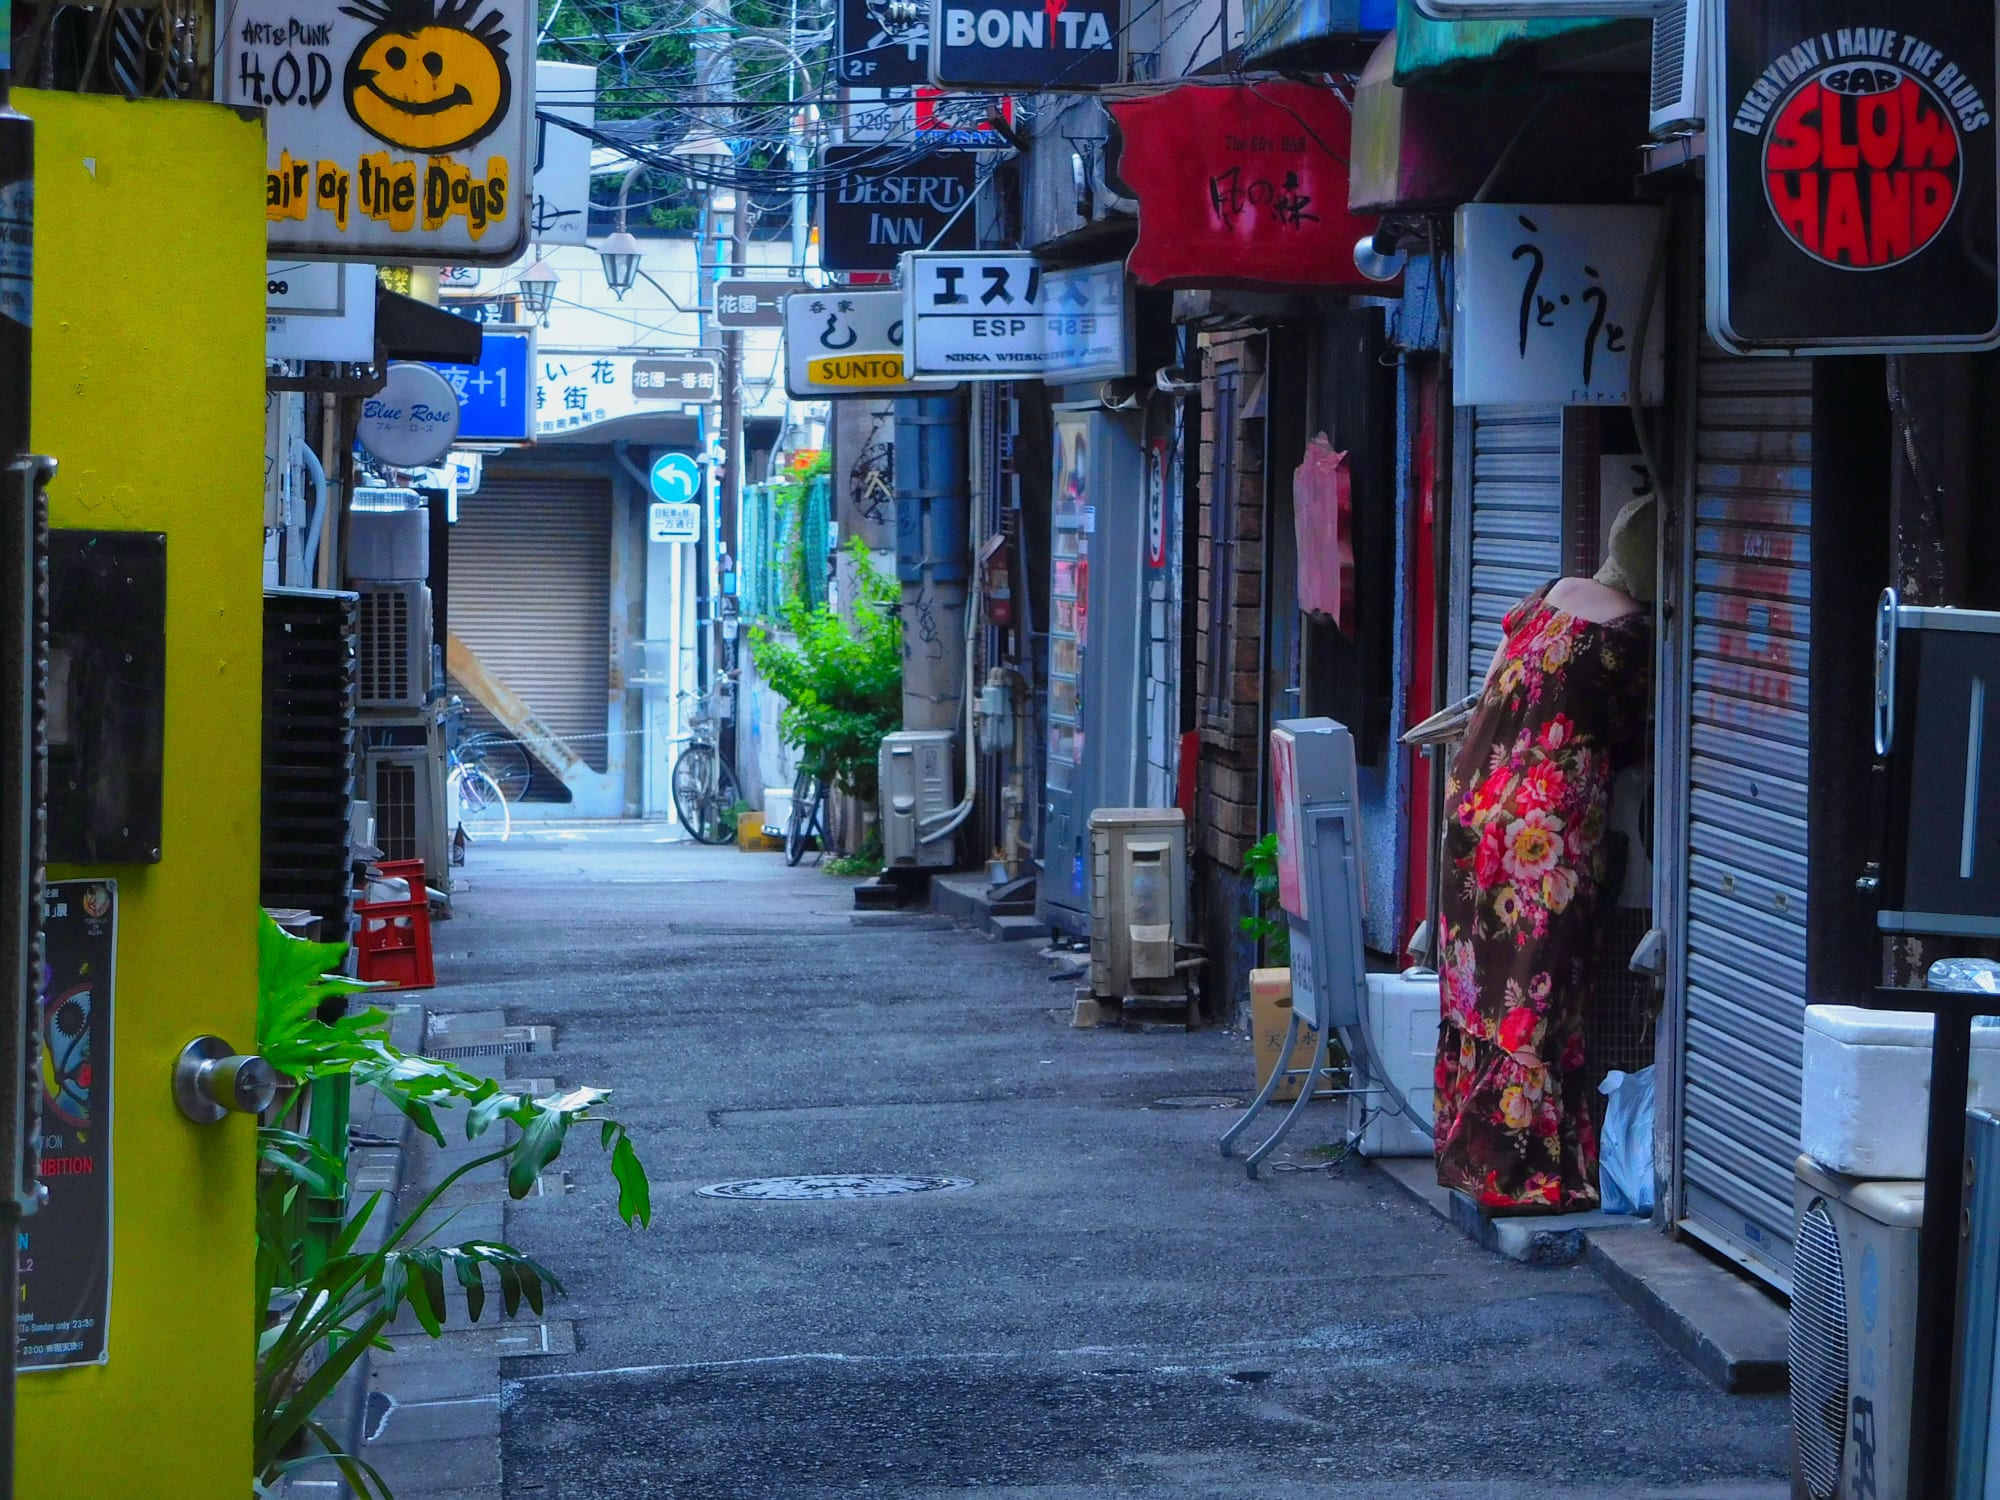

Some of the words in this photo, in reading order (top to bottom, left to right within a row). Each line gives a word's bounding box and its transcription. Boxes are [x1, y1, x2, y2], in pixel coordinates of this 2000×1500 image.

[946, 8, 1113, 51] BONITA
[850, 60, 878, 77] 2F
[1732, 38, 1820, 136] EVERYDAY
[1821, 33, 1835, 60] I
[1836, 27, 1898, 58] HAVE
[1899, 34, 1944, 78] THE
[1932, 61, 1991, 133] BLUES
[1825, 67, 1899, 95] BAR
[1766, 77, 1958, 171] SLOW
[319, 168, 348, 223] of
[360, 158, 415, 216] the
[427, 166, 505, 229] Dogs
[837, 174, 965, 214] DESERT
[868, 212, 924, 245] INN
[1766, 170, 1955, 266] HAND
[972, 319, 1026, 338] ESP
[823, 359, 904, 380] SUNTO
[945, 353, 990, 363] NIKKA
[633, 370, 713, 389] 花園一番街
[363, 401, 401, 420] Blue
[409, 404, 450, 422] Rose
[1266, 1031, 1317, 1048] 天水
